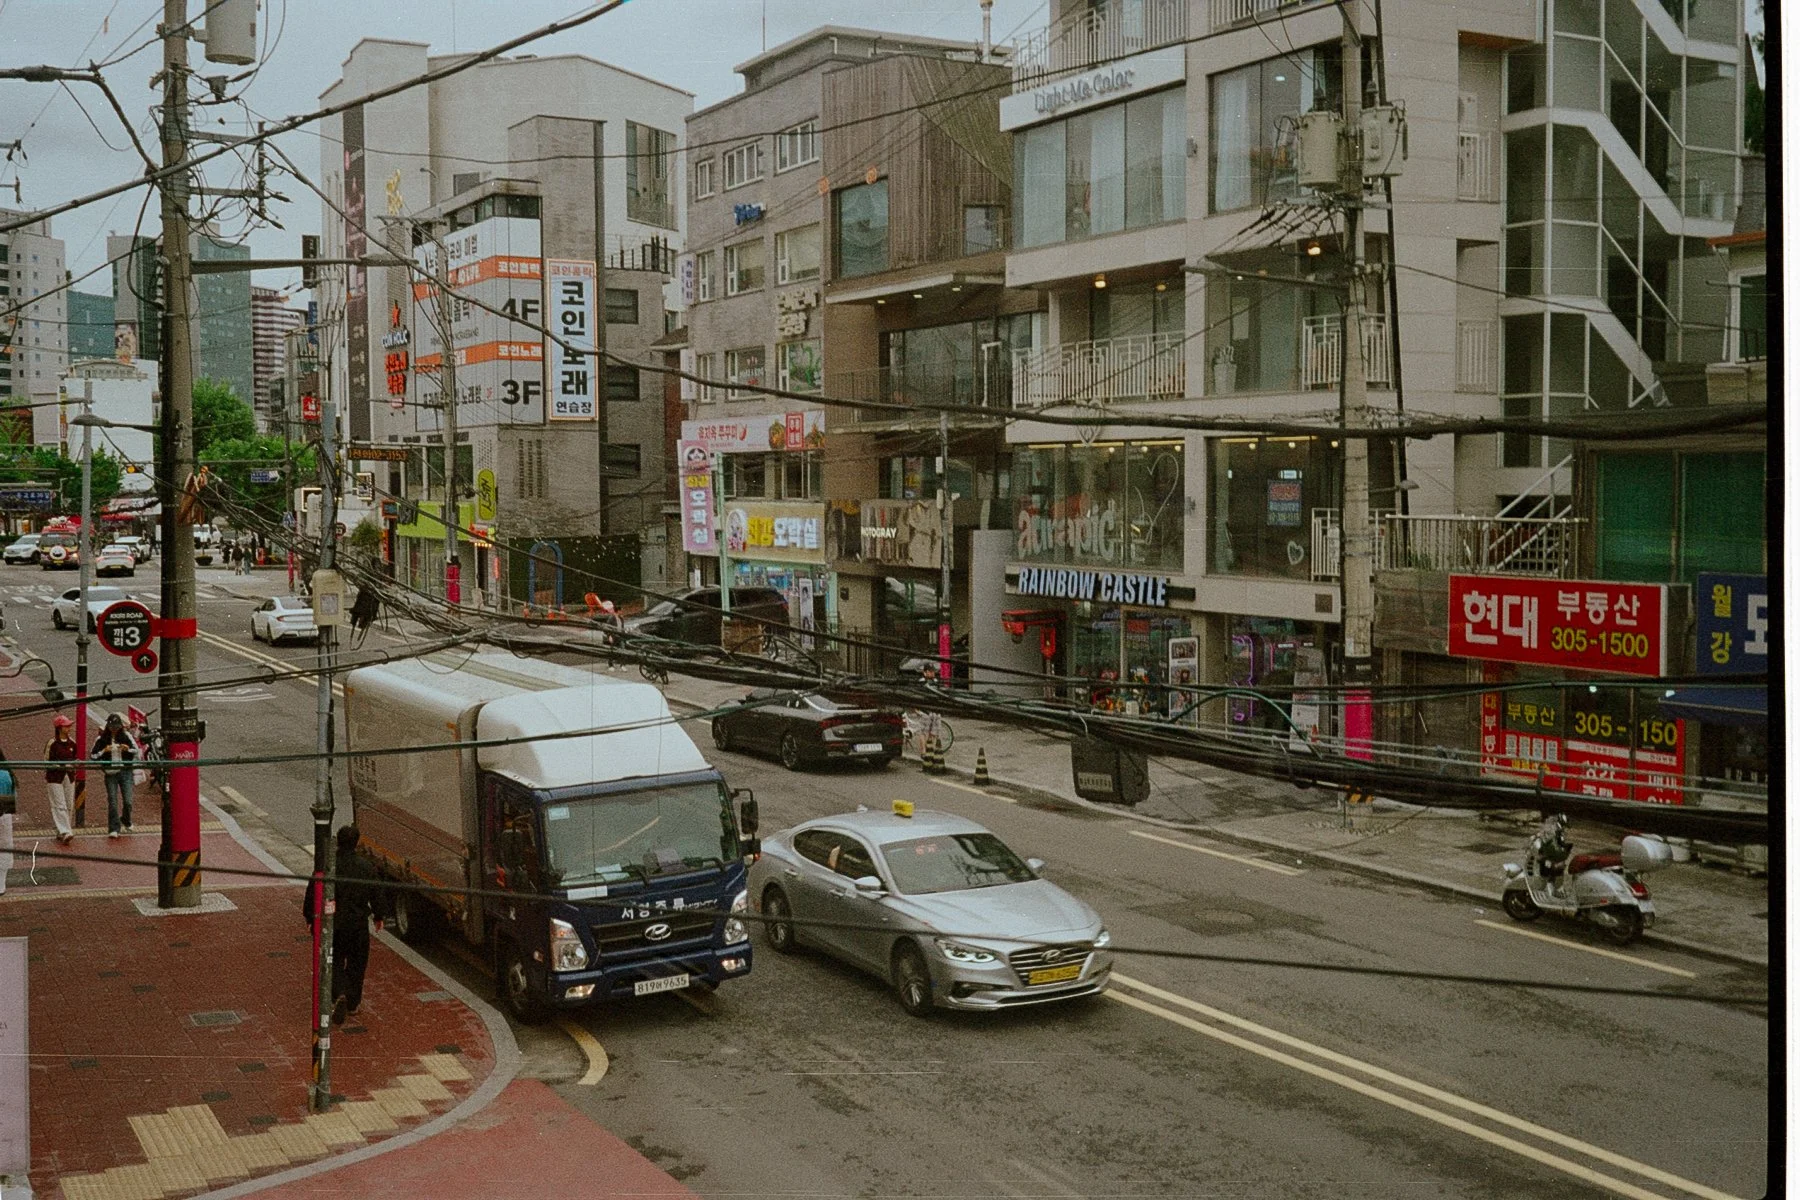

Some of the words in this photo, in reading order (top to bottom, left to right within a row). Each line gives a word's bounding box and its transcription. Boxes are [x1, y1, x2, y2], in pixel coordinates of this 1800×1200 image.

[1093, 68, 1133, 95] Color
[500, 298, 539, 321] 4F
[560, 281, 588, 395] 코인노래
[501, 379, 541, 405] 3F
[556, 401, 592, 414] 연습장
[1018, 566, 1096, 600] RAINBOW
[1101, 573, 1168, 607] CASTLE
[1462, 590, 1538, 649] 현대
[1557, 590, 1641, 626] 부동산
[125, 626, 141, 647] 3
[1551, 627, 1649, 657] 305-1500
[1508, 703, 1555, 727] 부동산
